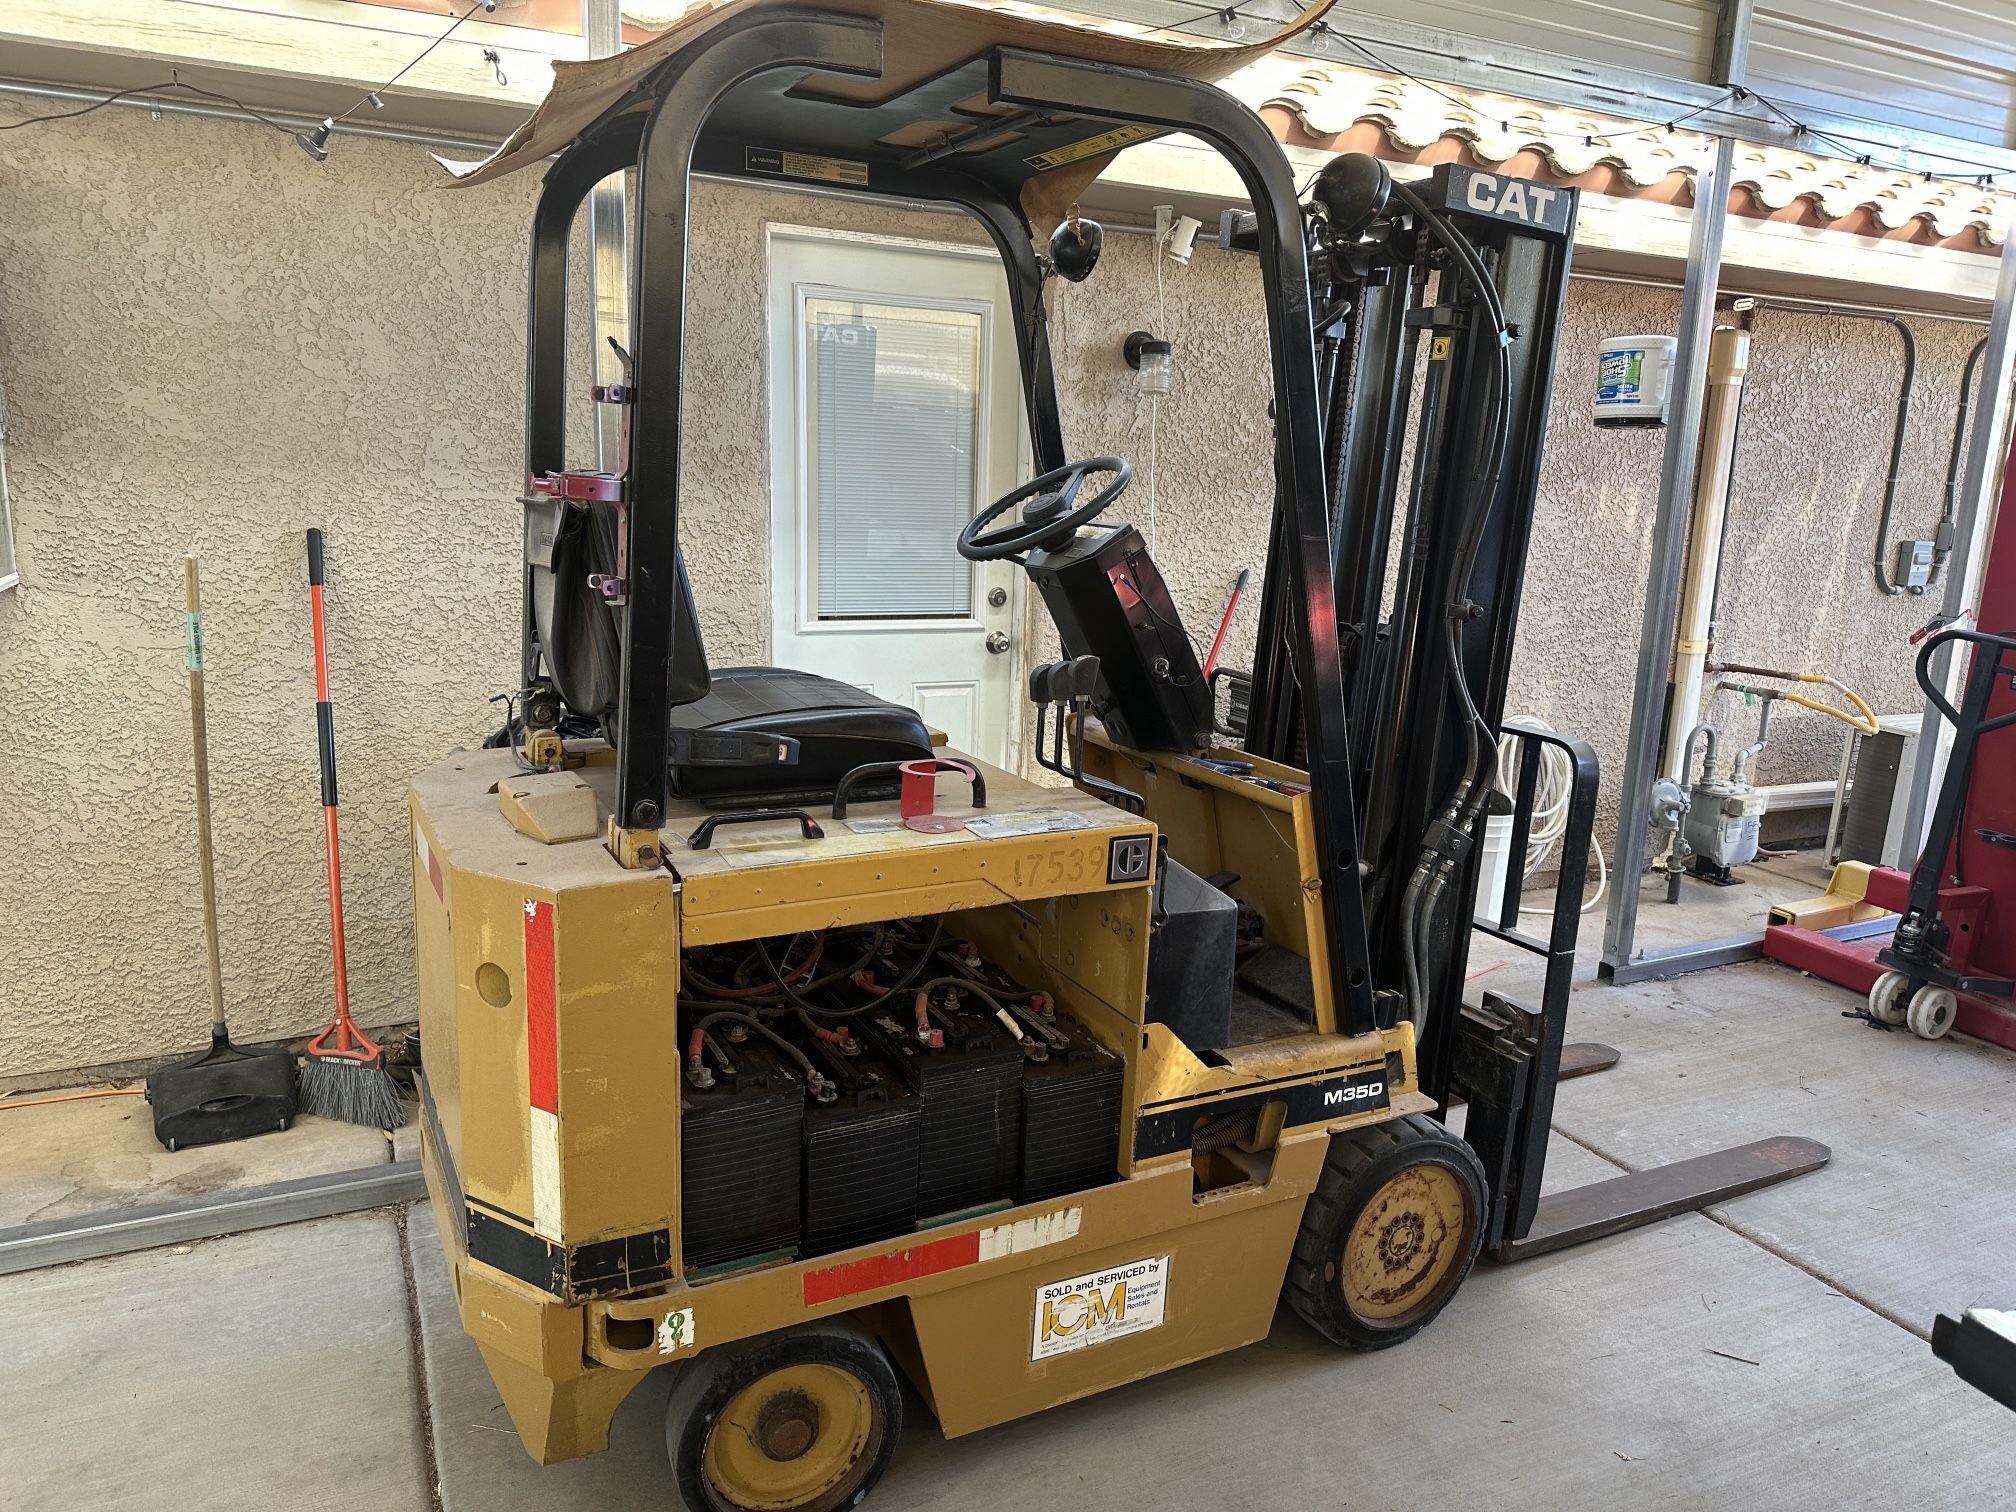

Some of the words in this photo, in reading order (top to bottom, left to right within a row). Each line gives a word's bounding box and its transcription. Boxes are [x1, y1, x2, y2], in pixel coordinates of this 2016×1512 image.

[1467, 172, 1555, 224] CAT
[1324, 1082, 1383, 1106] M35D
[1044, 1285, 1073, 1300] SOLD
[1075, 1279, 1094, 1292] and
[1097, 1265, 1146, 1287] SERVICED
[1148, 1263, 1160, 1276] by
[1127, 1280, 1161, 1295] Equipment
[1126, 1298, 1151, 1311] Rentals
[1127, 1292, 1145, 1303] Sales
[1146, 1288, 1158, 1298] and
